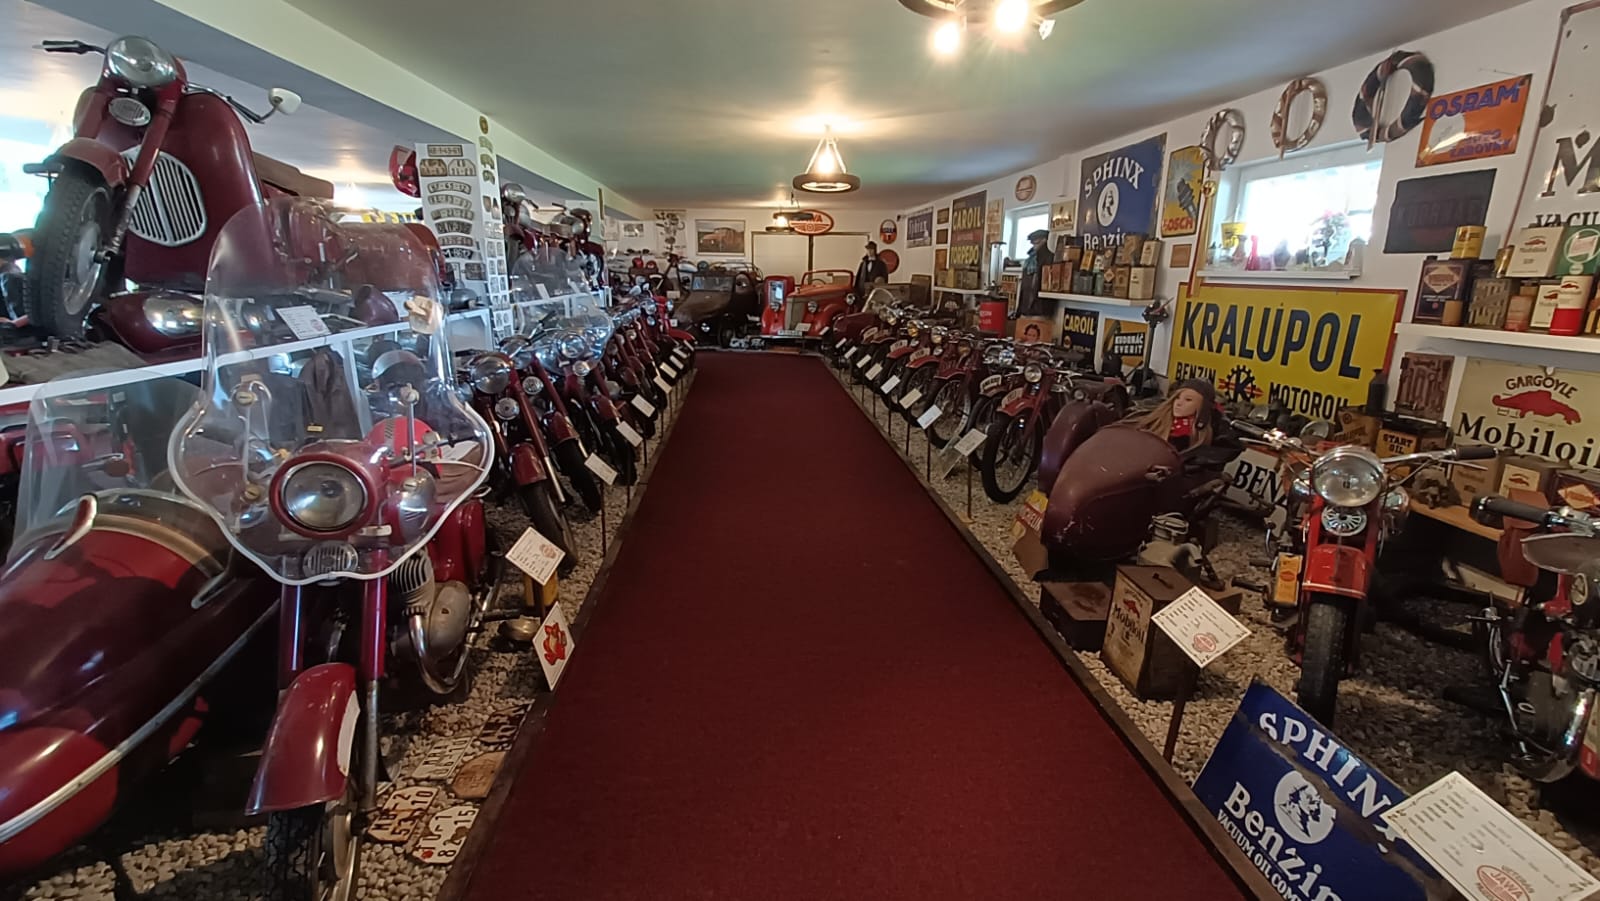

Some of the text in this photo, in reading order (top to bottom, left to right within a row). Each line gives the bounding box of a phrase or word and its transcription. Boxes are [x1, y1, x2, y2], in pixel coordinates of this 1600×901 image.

[1429, 83, 1520, 120] OSRAM
[1084, 157, 1144, 199] SPHINX
[1063, 314, 1095, 336] CAROIL
[1505, 375, 1578, 399] GARGOYLE
[1383, 433, 1414, 448] START
[1388, 444, 1405, 455] OIL
[1217, 809, 1254, 858] VACUUM
[1254, 853, 1272, 878] OIL
[1490, 872, 1523, 899] JAWA
